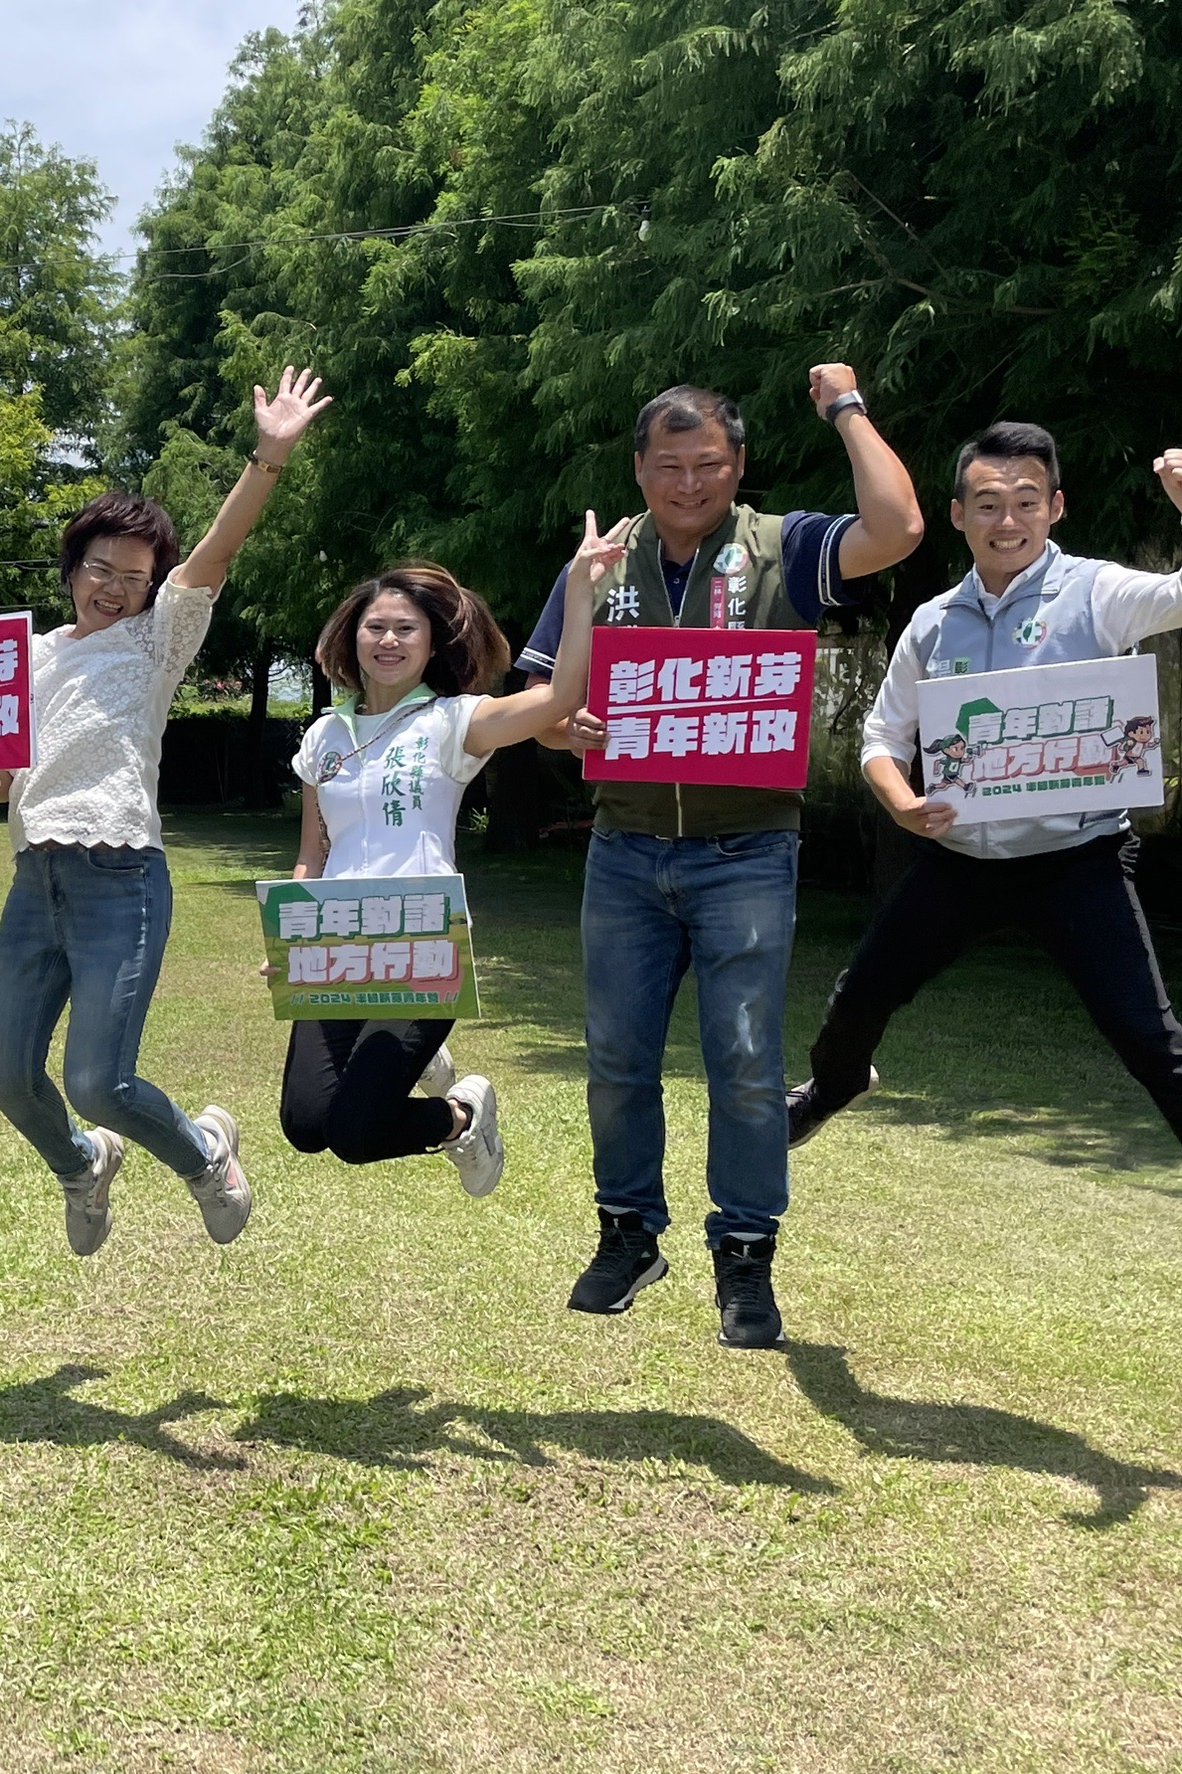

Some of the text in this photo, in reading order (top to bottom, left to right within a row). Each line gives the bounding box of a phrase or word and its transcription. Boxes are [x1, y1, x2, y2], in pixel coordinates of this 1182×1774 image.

[606, 585, 640, 628] 洪
[608, 651, 801, 703] 彰化新芽
[604, 709, 798, 761] 青年新政
[968, 695, 1114, 745] 青年對話
[972, 734, 1113, 782] 地方行動
[381, 745, 406, 826] 張欣倩
[982, 783, 1022, 796] 2024
[279, 893, 449, 940] 青年對話
[288, 939, 459, 985] 地方行動
[309, 993, 351, 1004] 2024
